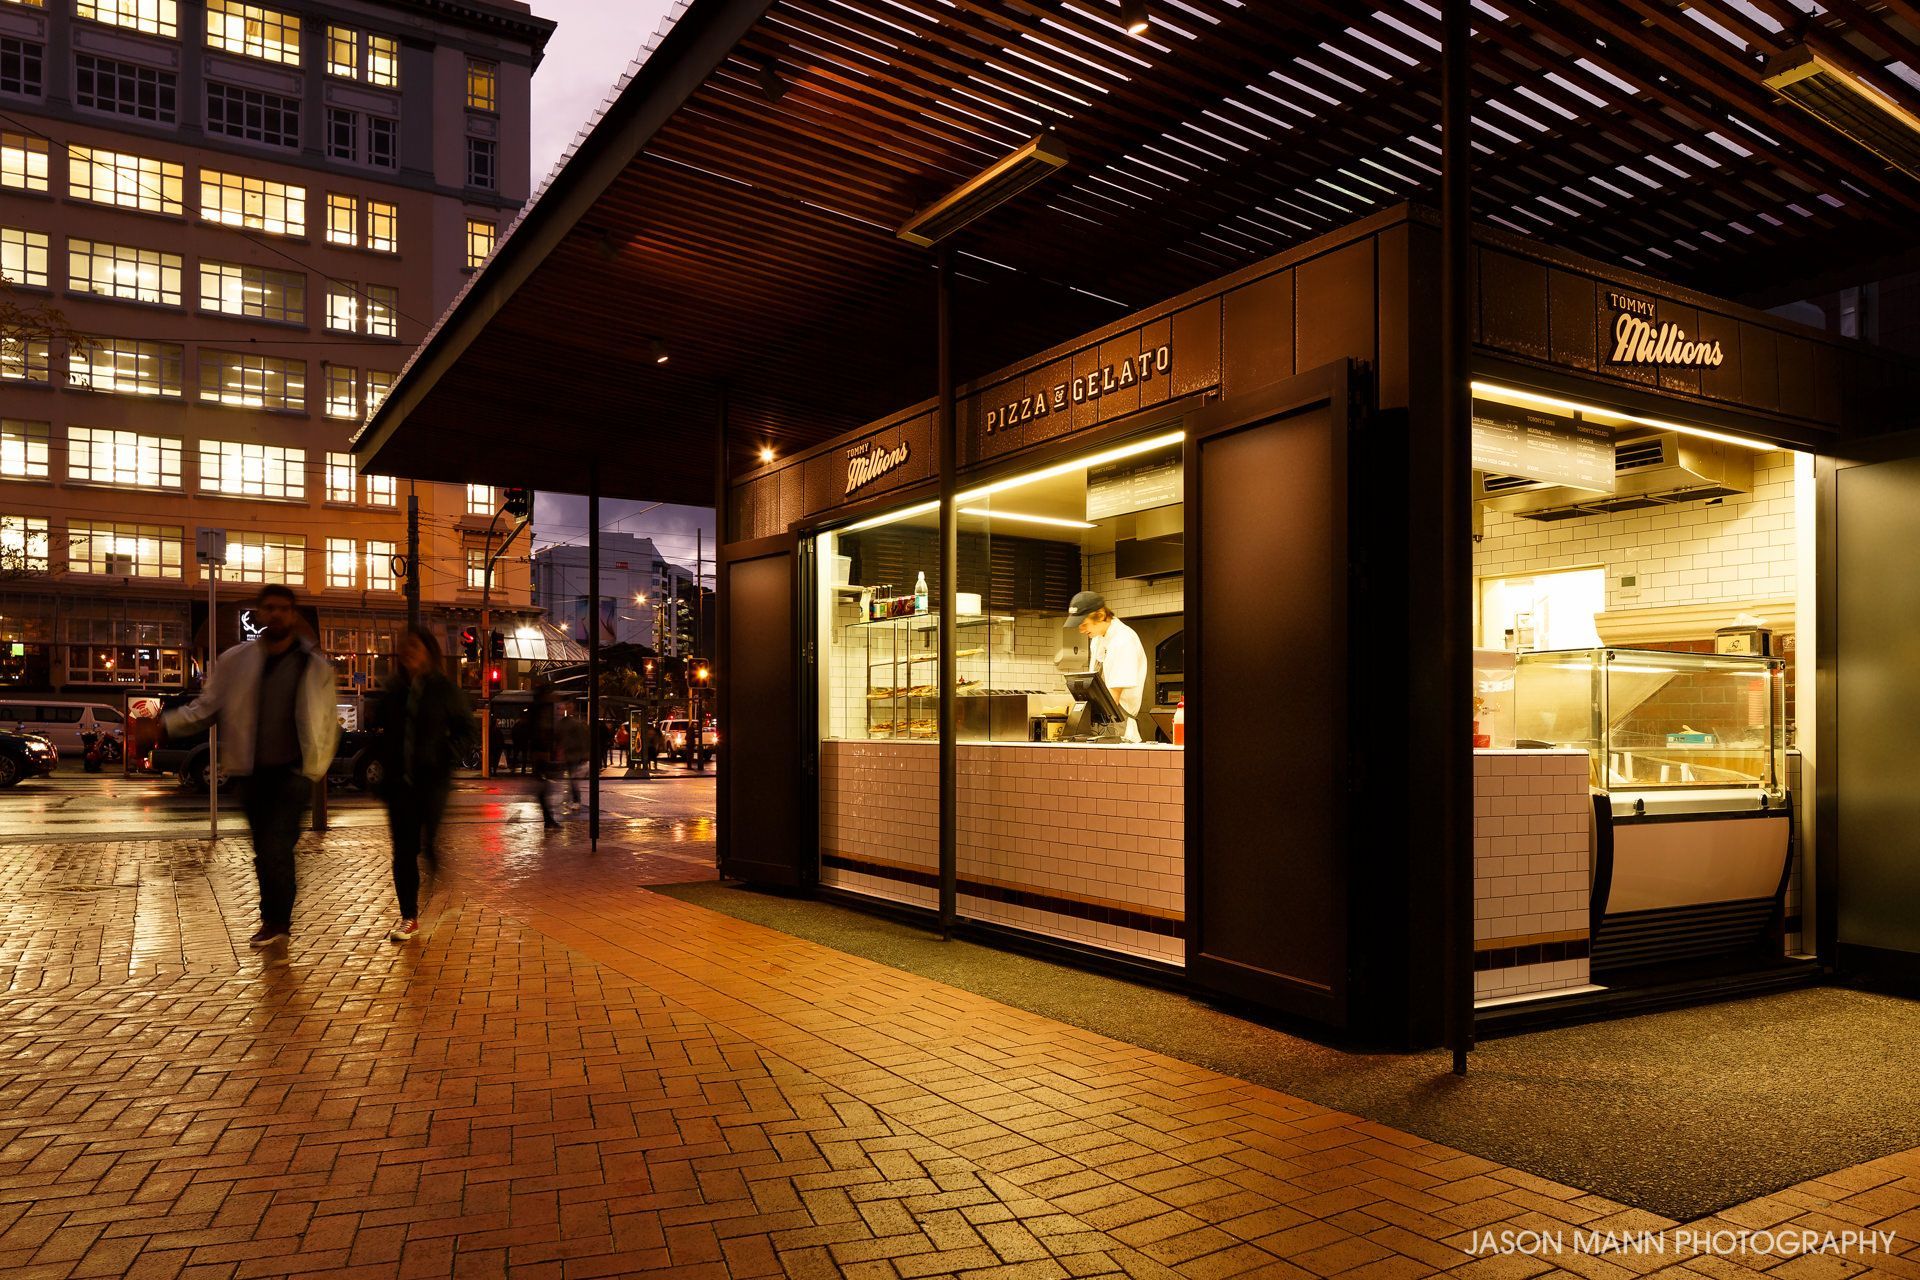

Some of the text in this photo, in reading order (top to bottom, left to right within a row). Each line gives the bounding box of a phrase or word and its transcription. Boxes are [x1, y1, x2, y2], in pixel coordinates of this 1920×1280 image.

[1610, 293, 1655, 317] TOMMY
[1612, 312, 1723, 367] Millions
[986, 346, 1169, 432] PIZZA & GELATO
[844, 441, 909, 495] Millions
[846, 442, 870, 459] TOMMY
